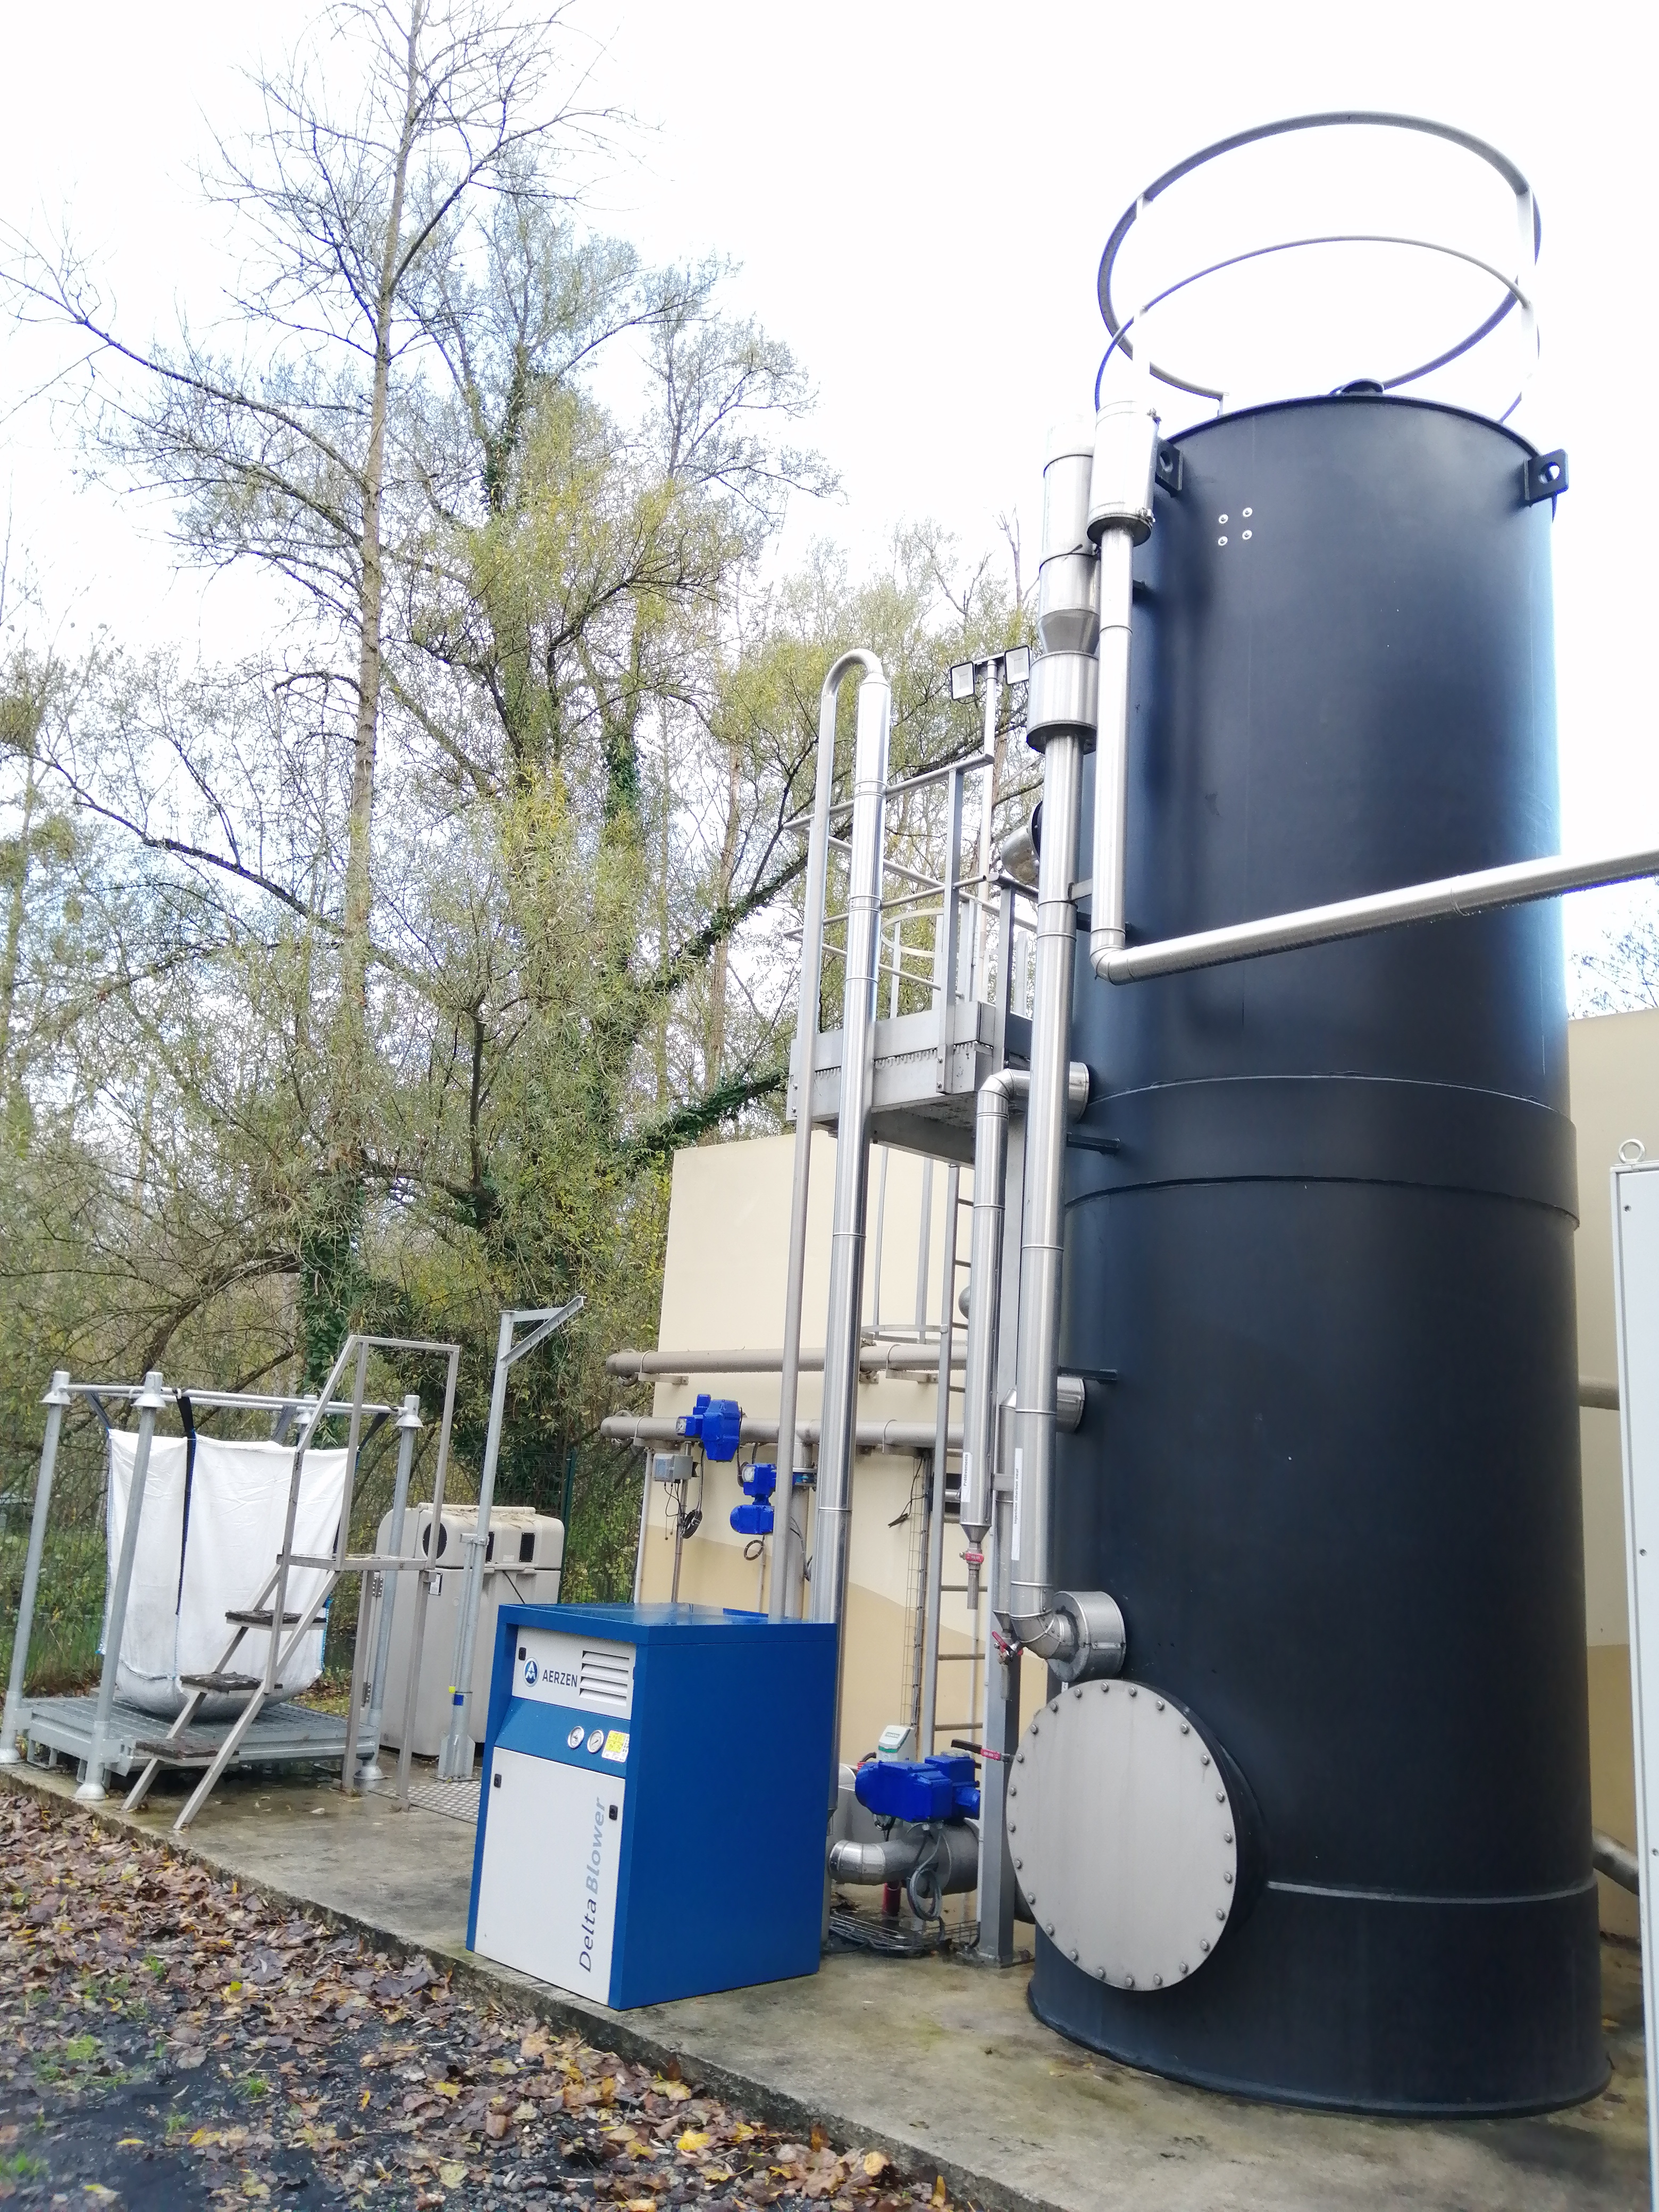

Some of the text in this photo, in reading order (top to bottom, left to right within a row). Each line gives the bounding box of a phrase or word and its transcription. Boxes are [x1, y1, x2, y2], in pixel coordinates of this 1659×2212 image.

[542, 1669, 577, 1688] AERZEN
[579, 1796, 606, 1973] Delta Blower
